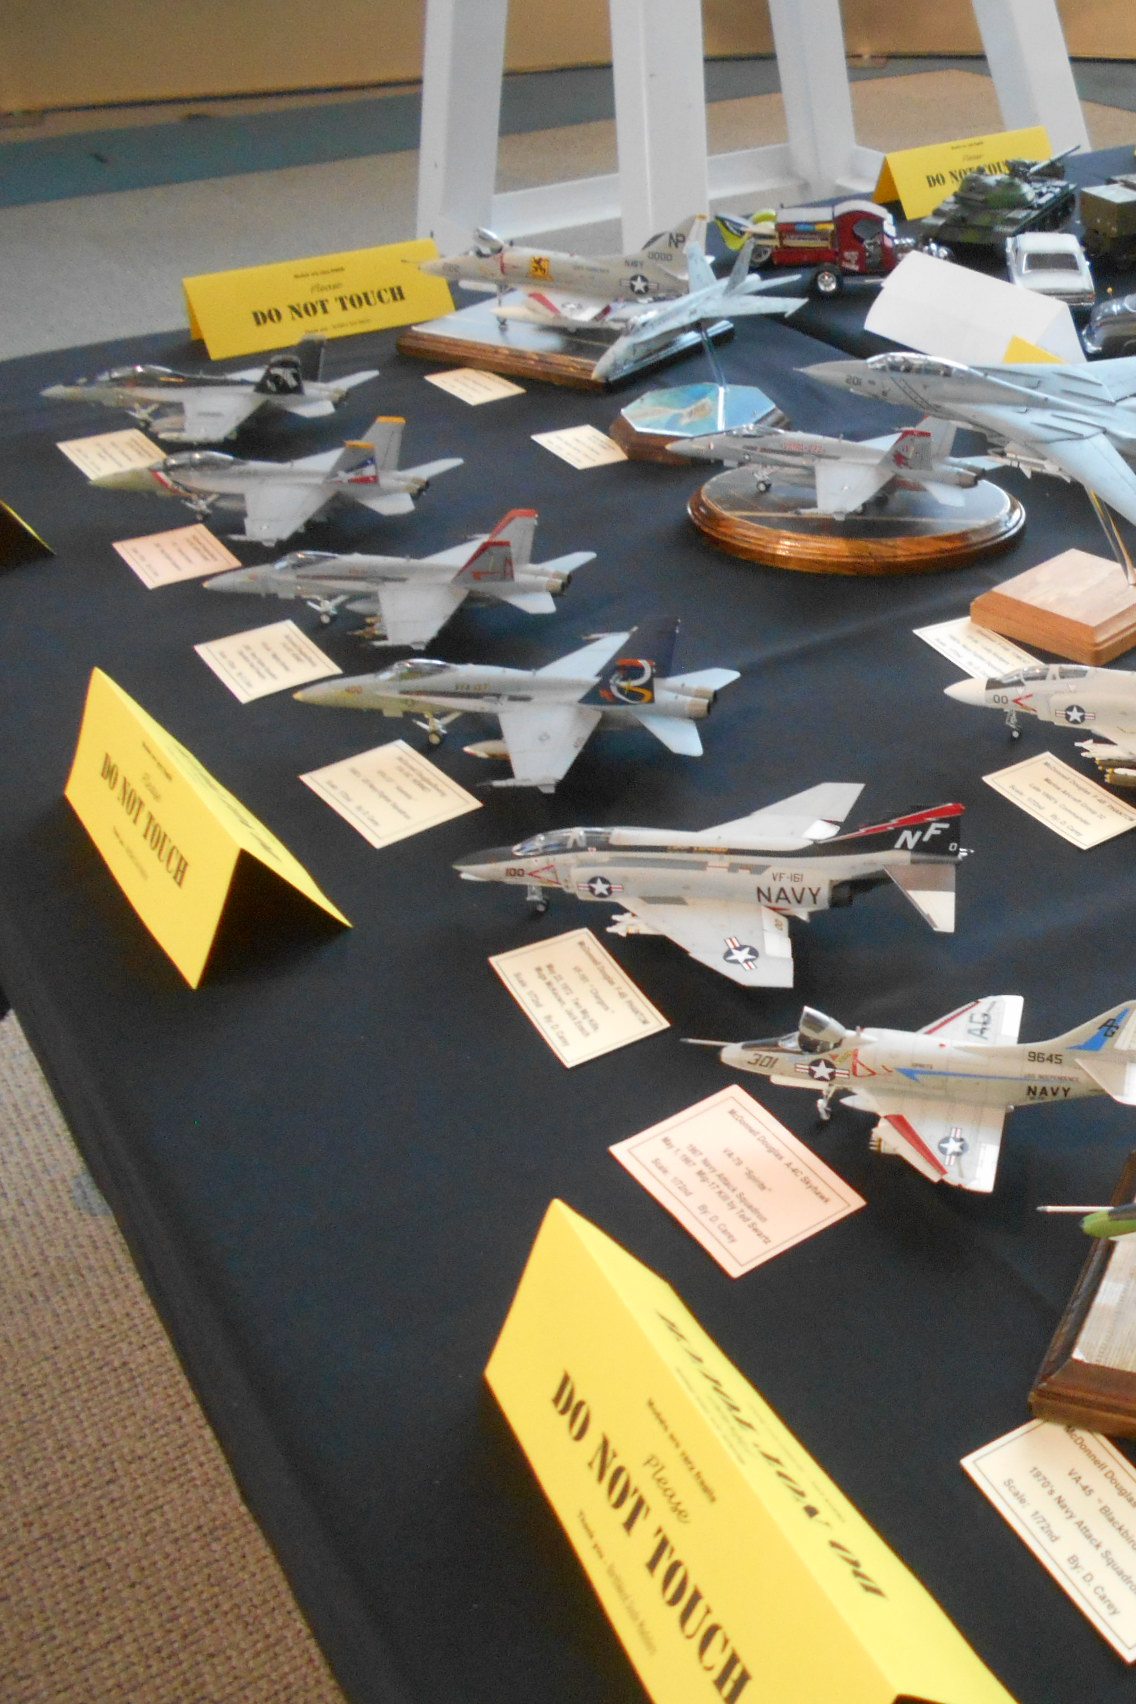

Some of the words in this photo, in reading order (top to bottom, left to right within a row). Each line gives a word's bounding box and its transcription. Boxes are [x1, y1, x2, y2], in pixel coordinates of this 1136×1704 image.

[926, 173, 946, 188] DO
[668, 232, 686, 248] NP
[252, 309, 282, 327] DO
[288, 299, 330, 321] NOT
[334, 285, 406, 313] TOUCH
[101, 752, 119, 790] DO
[119, 776, 145, 825] NOT
[142, 810, 189, 889] TOUCH
[894, 823, 949, 849] NF
[505, 868, 525, 878] 100
[772, 872, 804, 883] VF-161
[756, 886, 821, 905] NAVY
[748, 1053, 779, 1068] 301
[1027, 1051, 1063, 1065] 9645
[1026, 1085, 1071, 1098] NAVY
[726, 1108, 761, 1137] McDonnell
[754, 1135, 786, 1161] Douglas
[797, 1175, 833, 1204] Skyhawk
[697, 1157, 719, 1174] Navy
[714, 1172, 738, 1193] Attack
[732, 1191, 770, 1224] Squadron
[713, 1222, 739, 1244] Carey
[641, 1447, 696, 1531] Please
[1065, 1467, 1095, 1498] VA-45
[1027, 1464, 1058, 1497] 1970's
[1051, 1494, 1078, 1521] Navy
[1072, 1518, 1104, 1551] Attack
[550, 1369, 590, 1443] DO
[588, 1434, 652, 1539] NOT
[645, 1522, 753, 1704] TOUCH
[1027, 1509, 1061, 1544] 1/72nd
[1089, 1584, 1122, 1618] Carey
